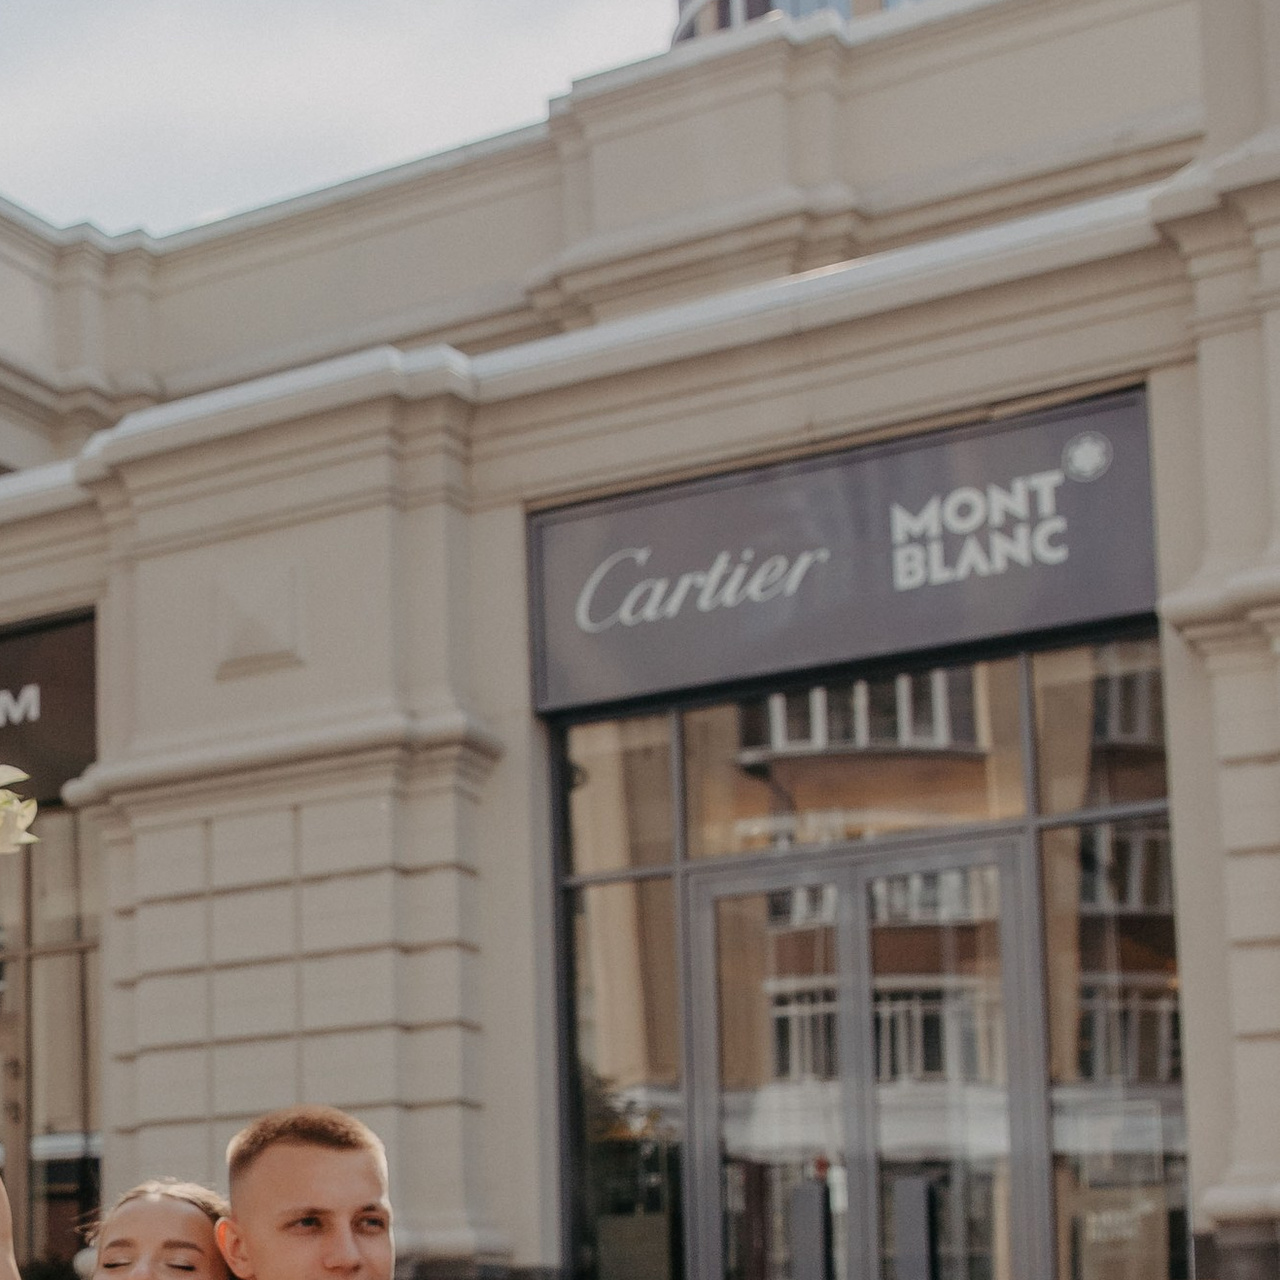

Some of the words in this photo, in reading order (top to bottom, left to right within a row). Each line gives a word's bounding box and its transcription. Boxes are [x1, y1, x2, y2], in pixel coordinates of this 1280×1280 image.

[889, 468, 1066, 547] MONT
[575, 546, 831, 634] Cartier
[892, 515, 1070, 592] BLANC
